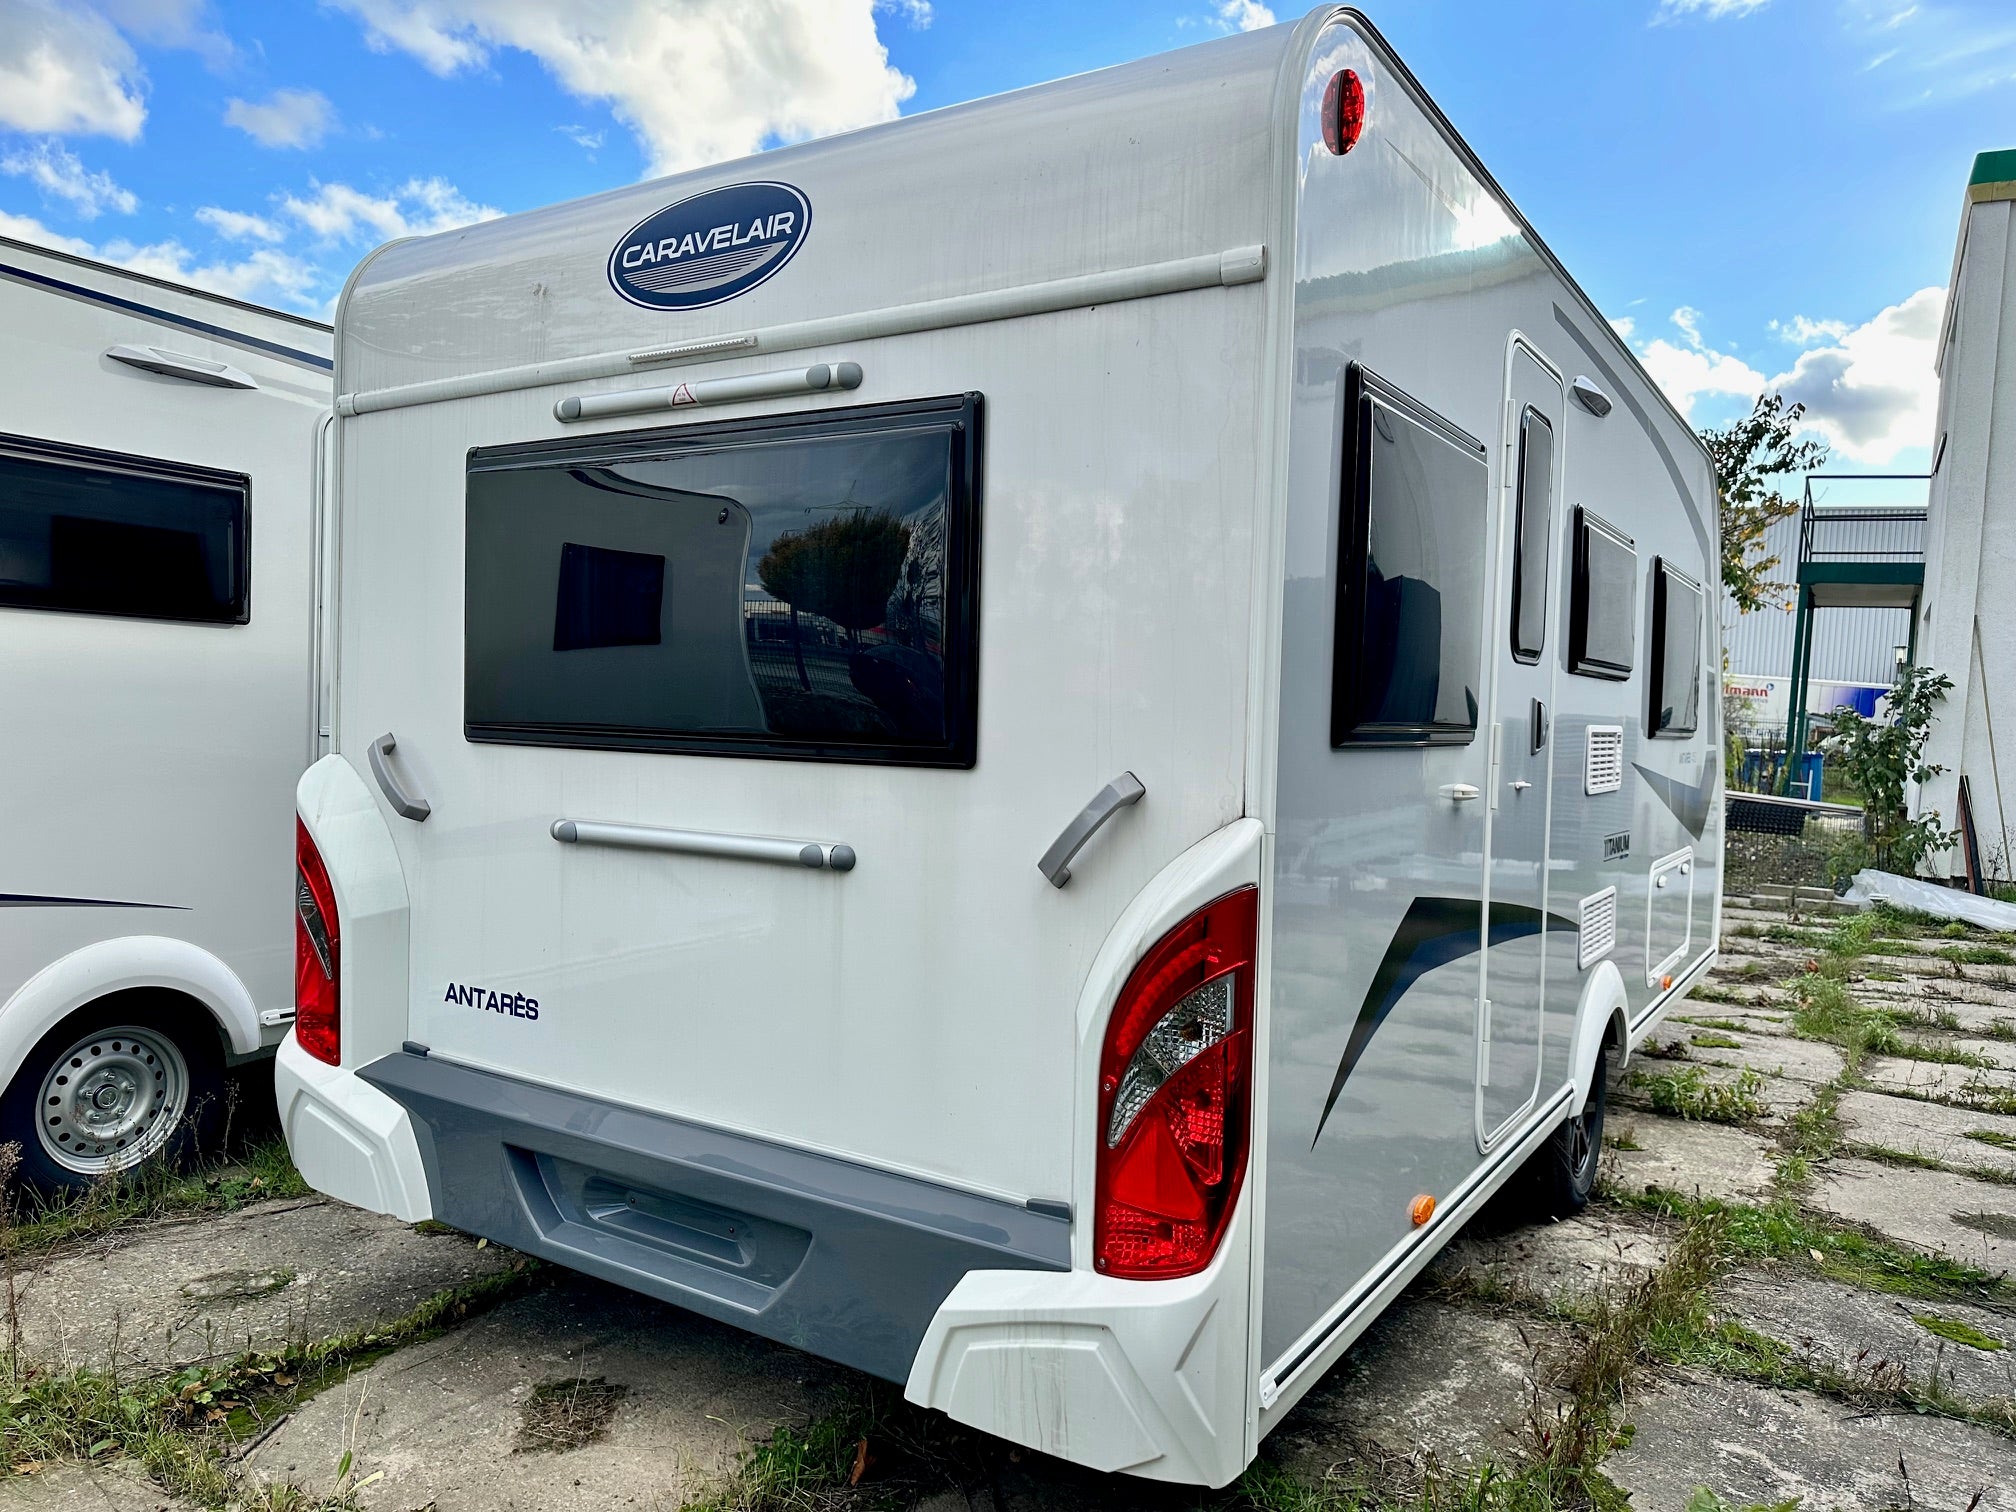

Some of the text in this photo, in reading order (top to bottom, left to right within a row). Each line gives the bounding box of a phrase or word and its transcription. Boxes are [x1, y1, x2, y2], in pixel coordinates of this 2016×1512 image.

[622, 211, 795, 268] CARAVELAIR
[1724, 684, 1769, 697] lmann
[1603, 834, 1630, 858] TITANIUM
[444, 982, 539, 1021] ANTARÈS
